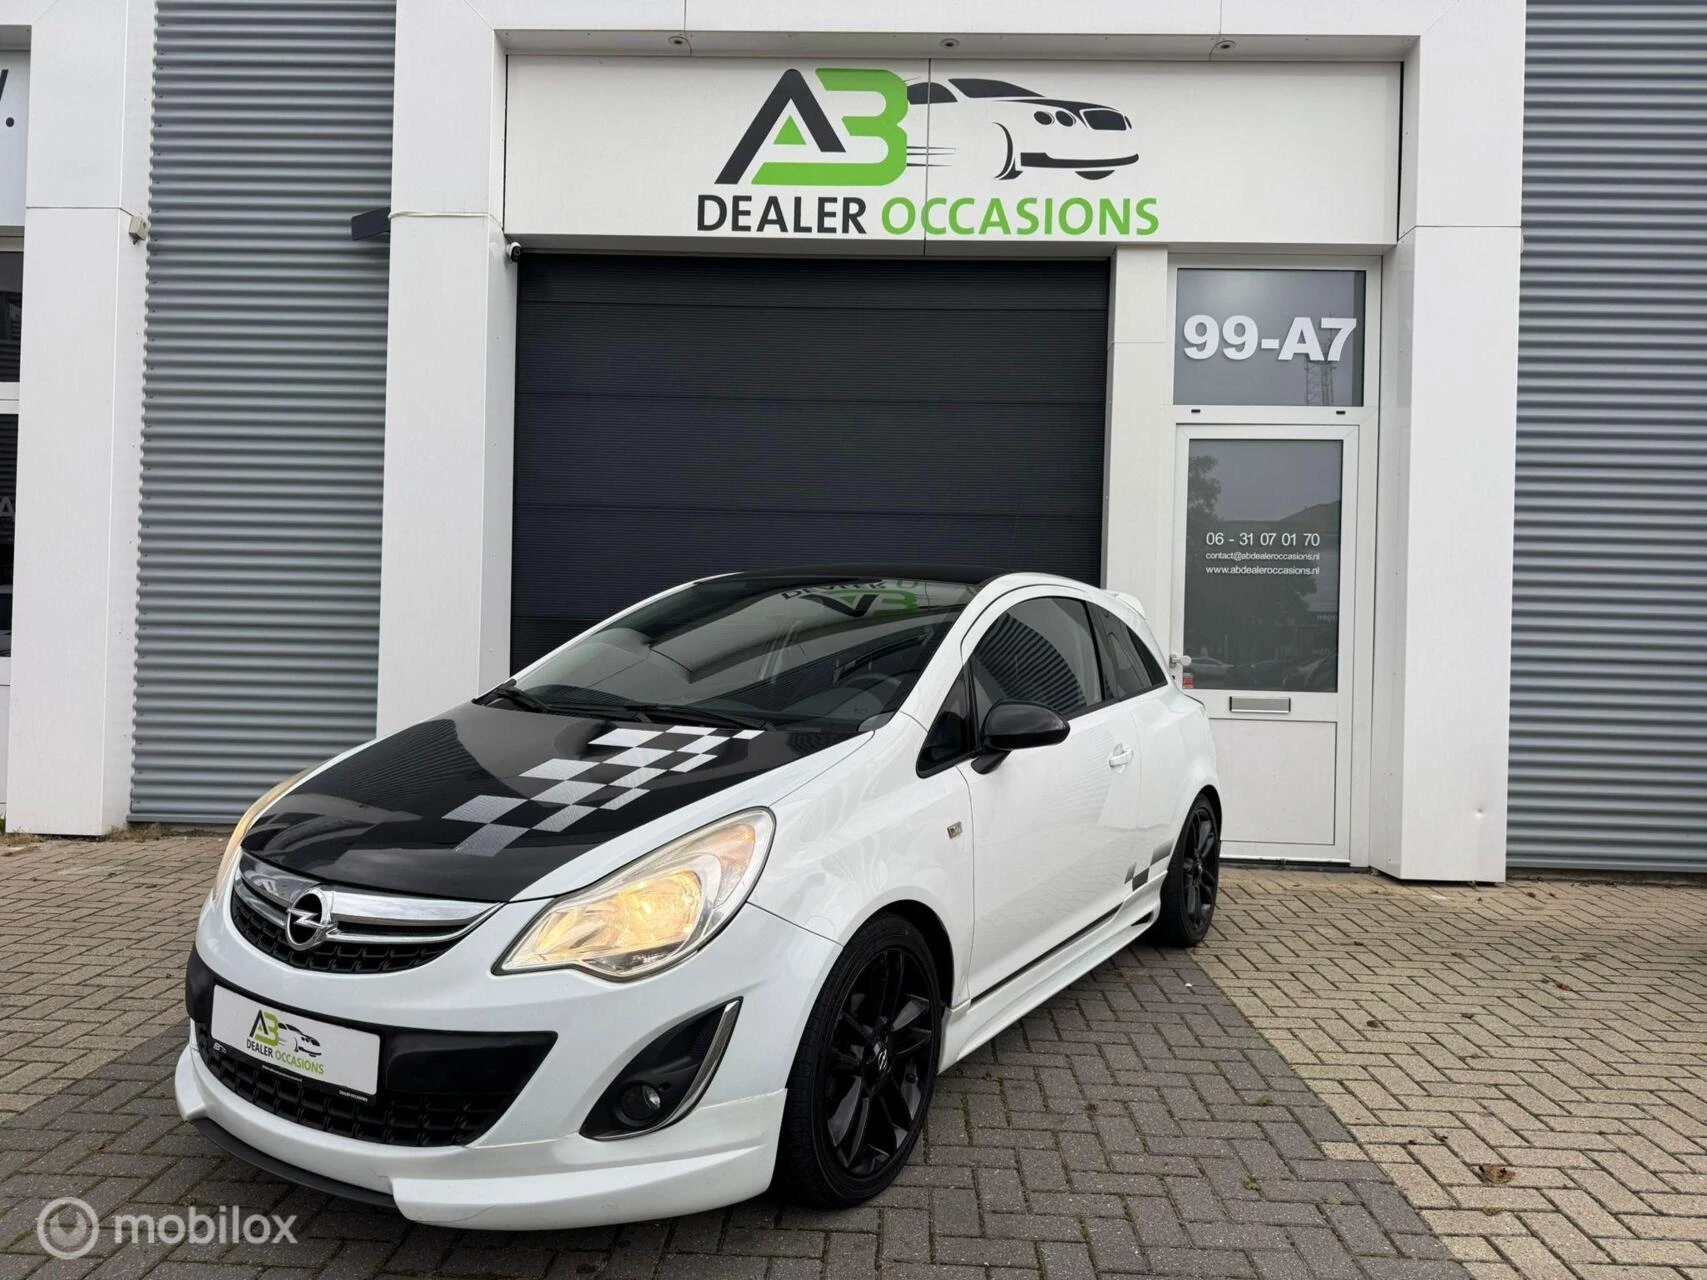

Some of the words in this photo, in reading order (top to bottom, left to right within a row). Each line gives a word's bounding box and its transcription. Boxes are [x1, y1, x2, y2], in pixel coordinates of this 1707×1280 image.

[714, 68, 908, 186] AB
[697, 194, 867, 235] DEALER
[881, 197, 1160, 236] OCCASIONS
[1183, 314, 1357, 361] 99-A7
[1205, 551, 1320, 561] contact@abdealeroccasions.nl
[1206, 532, 1225, 546] 06
[1239, 532, 1254, 546] 31
[1260, 532, 1277, 546] 07
[1281, 533, 1297, 546] 01
[1303, 533, 1320, 546] 70
[1205, 565, 1320, 575] www.abdealeroccasions.nl
[246, 1038, 274, 1058] DEALER
[275, 1051, 325, 1076] OCCASIONS
